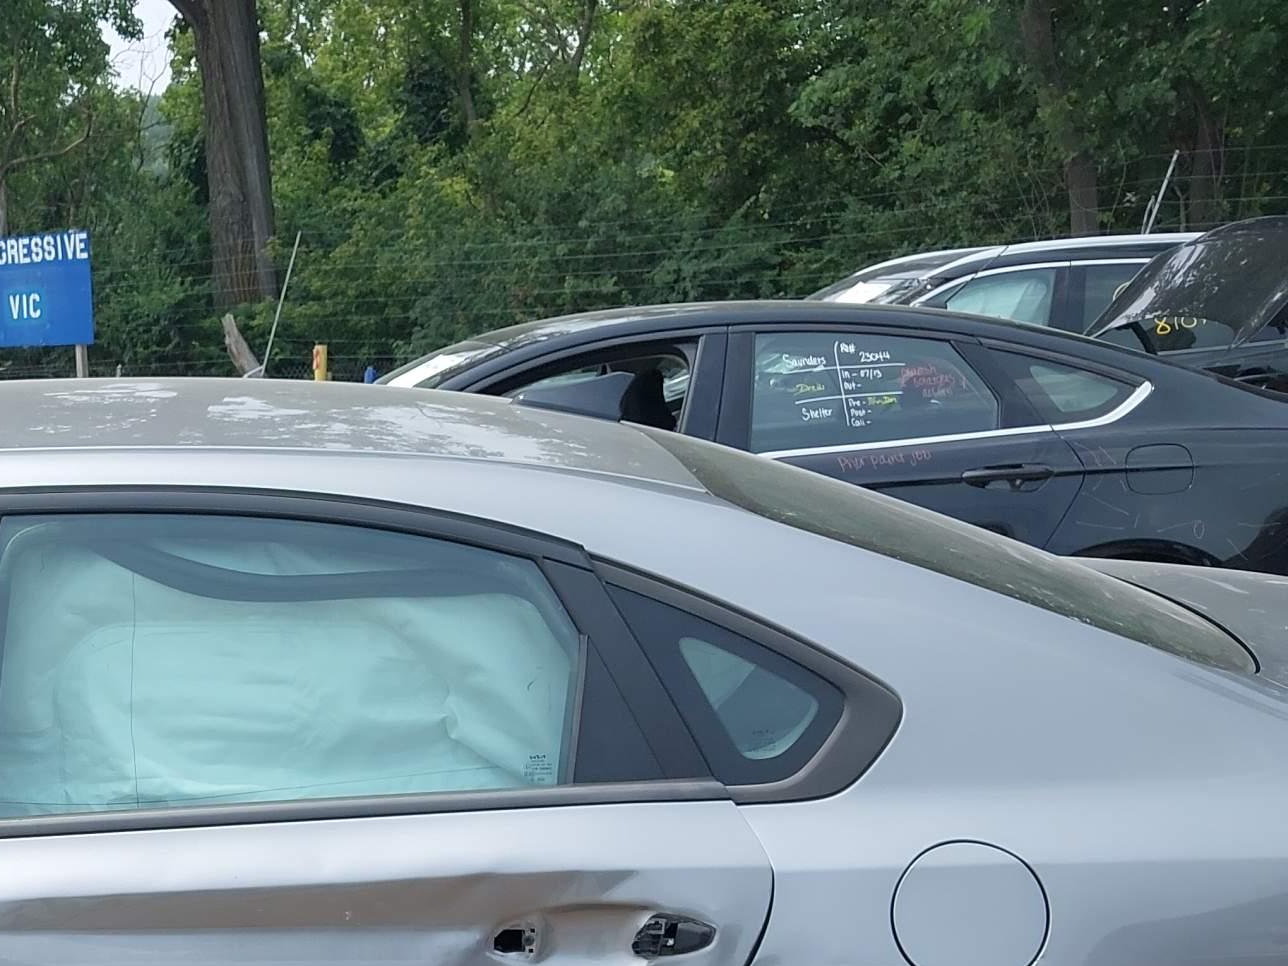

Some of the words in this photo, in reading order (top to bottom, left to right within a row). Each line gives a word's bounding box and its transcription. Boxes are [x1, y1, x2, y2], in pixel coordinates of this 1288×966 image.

[9, 292, 41, 320] VIC
[782, 353, 827, 369] Saunders
[859, 351, 890, 362] 23044
[801, 407, 832, 421] Shelter
